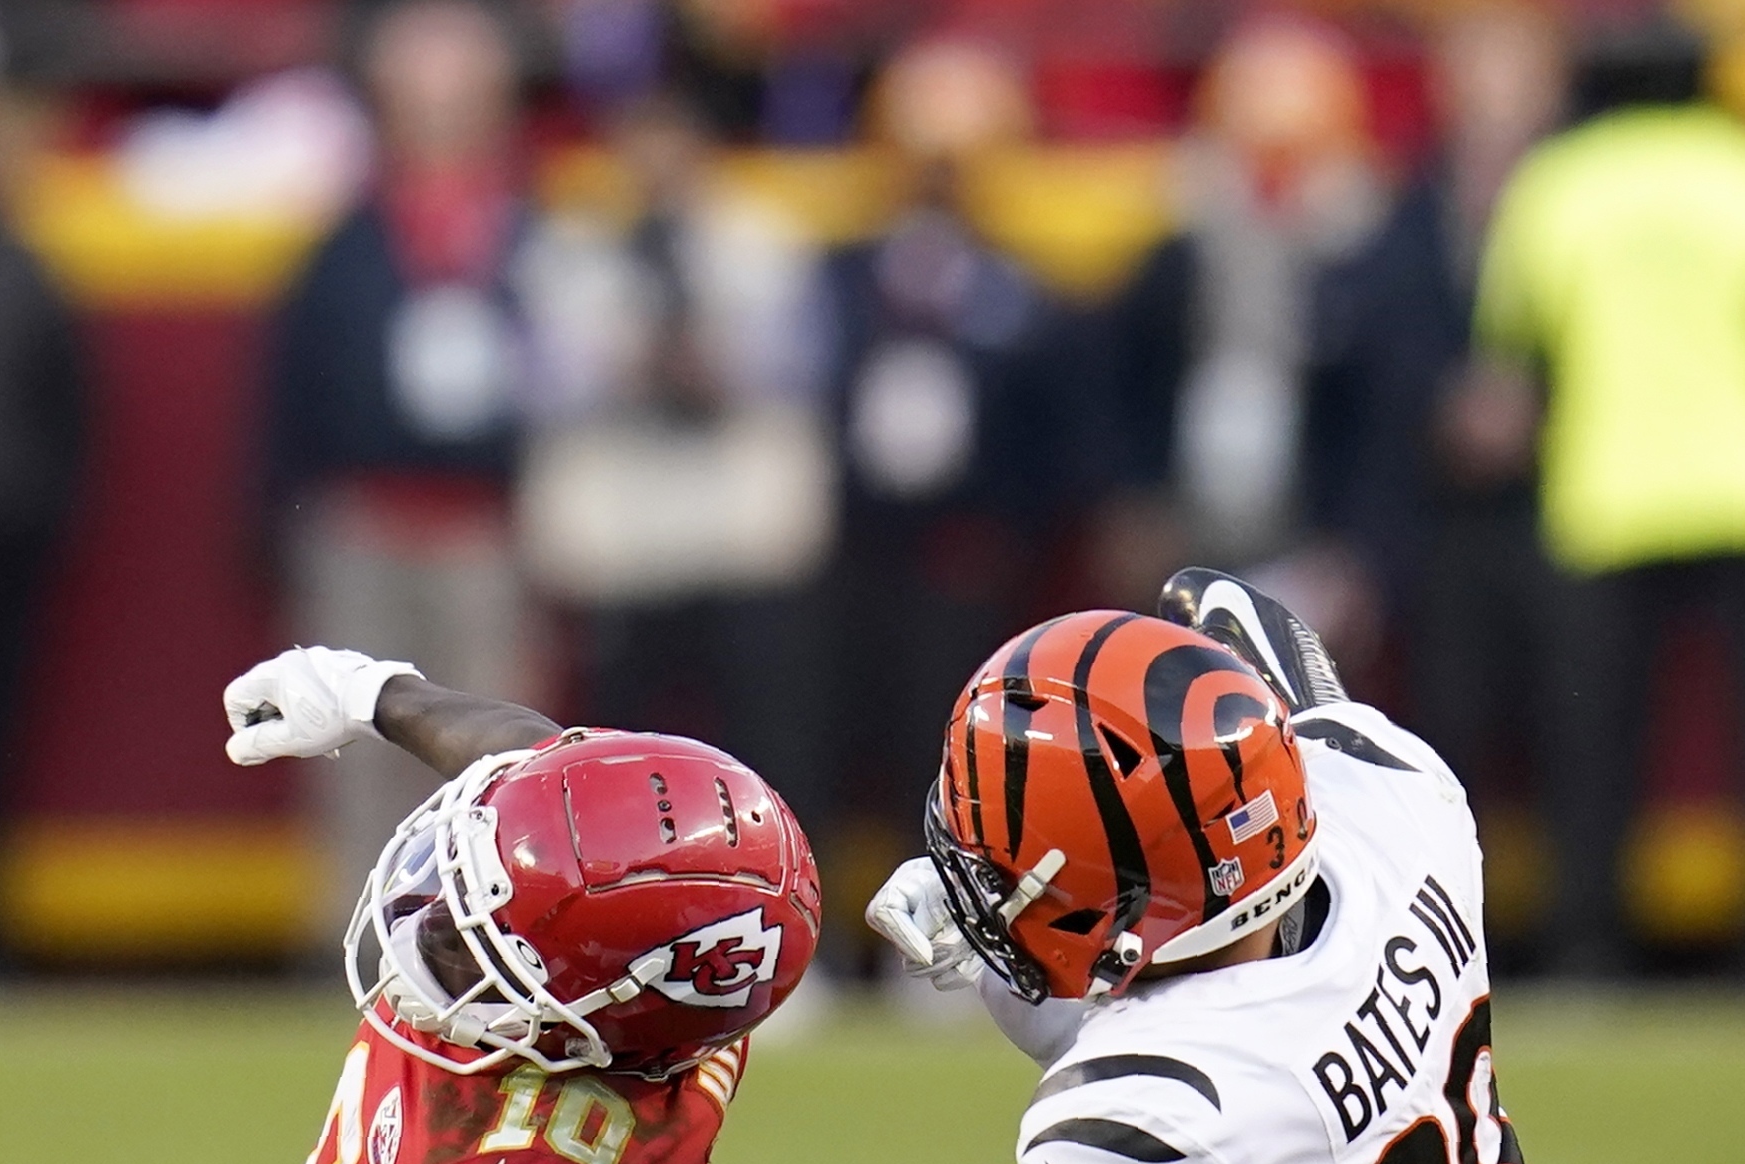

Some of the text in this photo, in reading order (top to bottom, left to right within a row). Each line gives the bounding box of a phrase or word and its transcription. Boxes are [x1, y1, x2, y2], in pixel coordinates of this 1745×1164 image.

[664, 936, 766, 996] KC
[1312, 874, 1476, 1144] BATES III
